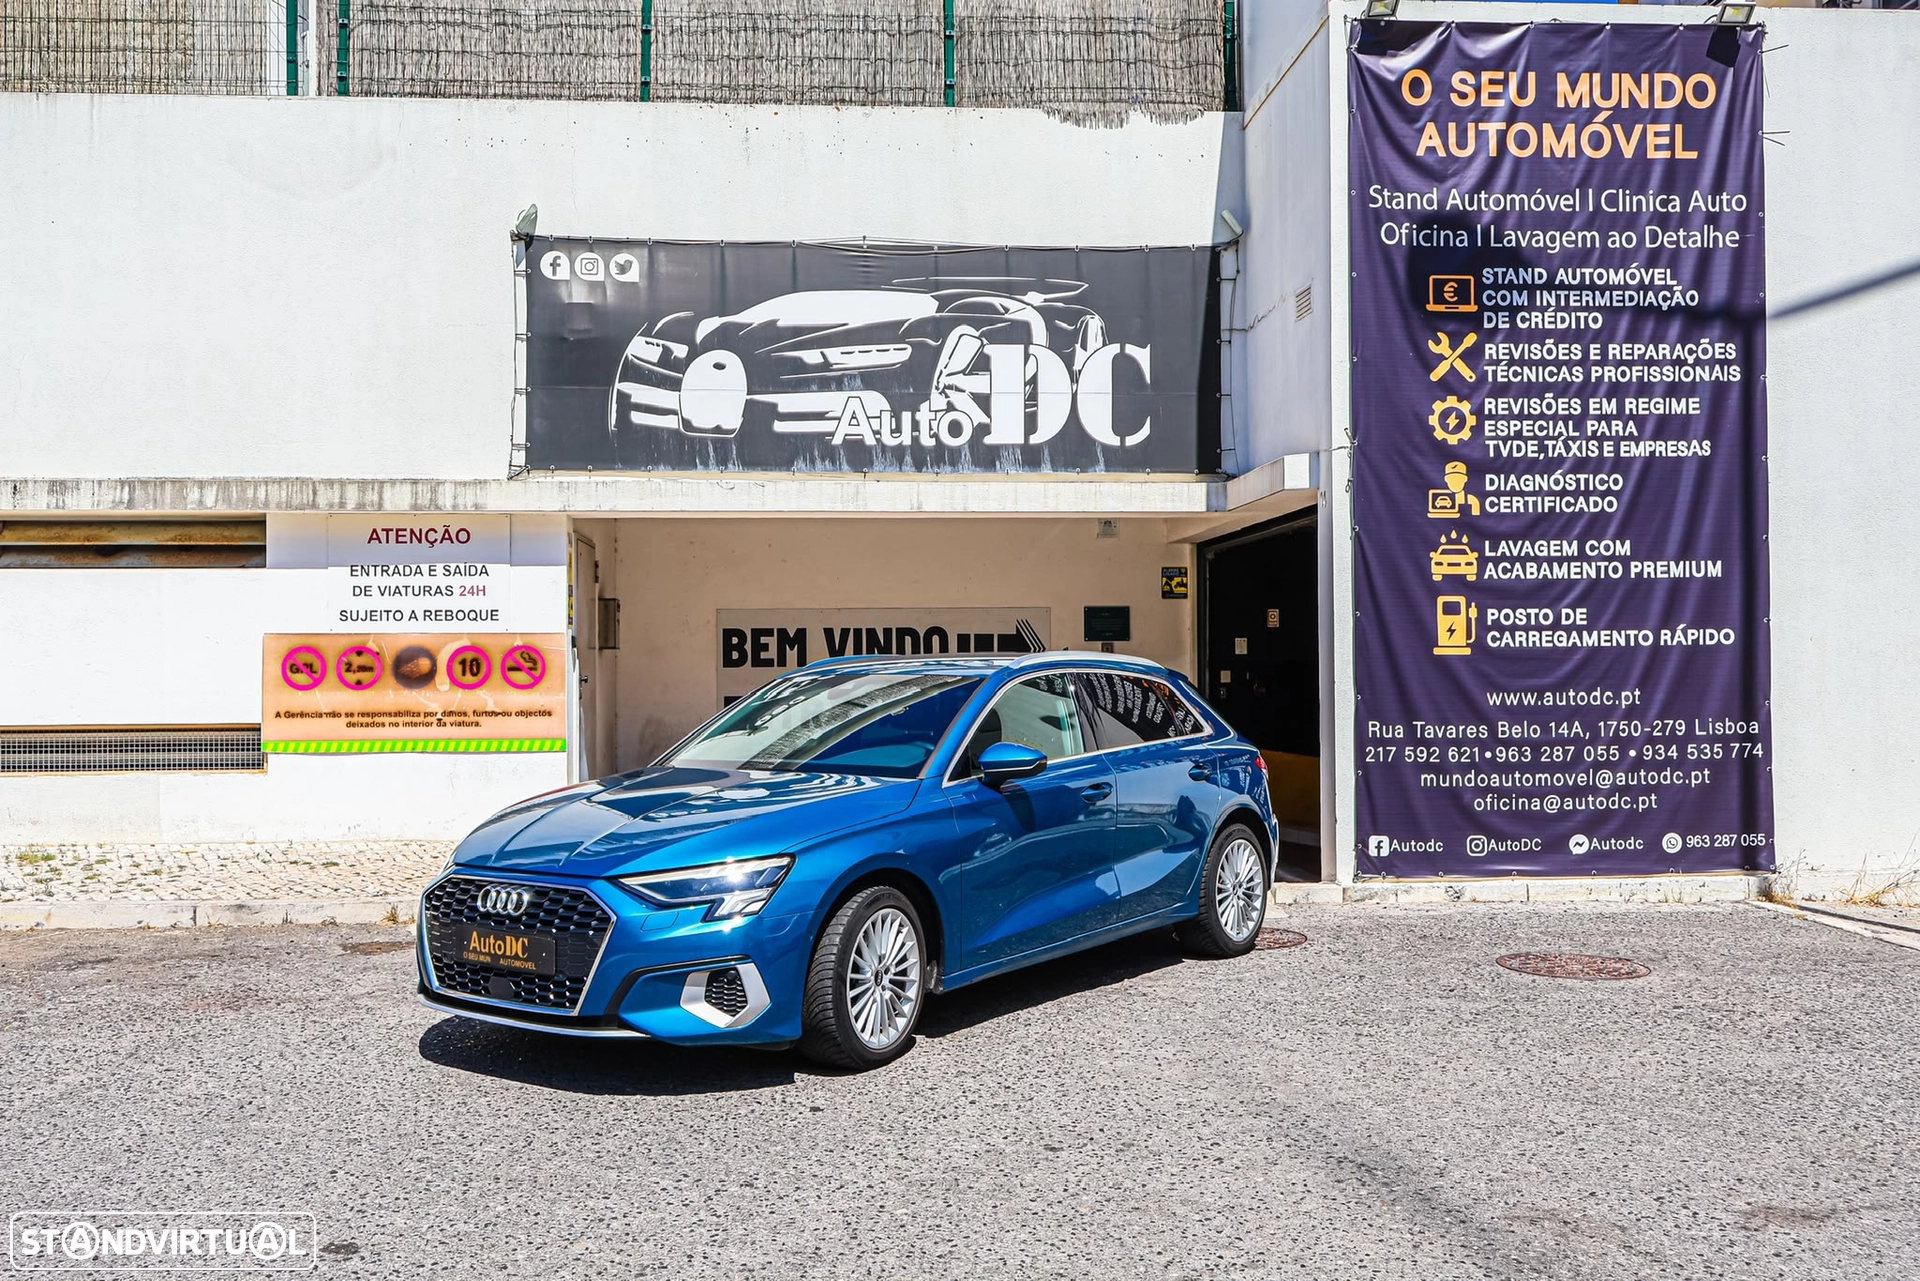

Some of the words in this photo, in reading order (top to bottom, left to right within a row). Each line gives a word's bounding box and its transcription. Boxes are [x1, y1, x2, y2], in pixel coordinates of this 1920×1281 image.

[1401, 69, 1432, 105] O
[1450, 70, 1537, 107] SEU
[1557, 73, 1716, 108] MUNDO
[1416, 111, 1698, 159] AUTOMÓVEL
[1369, 185, 1437, 210] Stand
[1446, 187, 1580, 211] Automóvel
[1601, 189, 1680, 212] Clinica
[1688, 190, 1746, 212] Auto
[1381, 222, 1468, 247] Oficina
[1491, 226, 1599, 253] Lavagem
[1608, 232, 1636, 248] ao
[1646, 225, 1739, 248] Detalhe
[1482, 268, 1547, 284] STAND
[1555, 263, 1677, 285] AUTOMÓVEL
[1483, 290, 1528, 306] COM
[1536, 285, 1698, 311] INTERMEDIAÇÃO
[1484, 312, 1509, 328] DE
[1517, 307, 1602, 329] CRÉDITO
[1485, 339, 1581, 359] REVISÕES
[1590, 344, 1601, 359] E
[1609, 338, 1736, 364] REPARAÇÕES
[1484, 361, 1583, 382] TÉCNICAS
[1591, 364, 1741, 382] PROFISSIONAIS
[831, 344, 1152, 447] AutoDC
[1485, 393, 1581, 415] REVISÕES
[1589, 398, 1616, 414] EM
[1625, 398, 1700, 414] REGIME
[1485, 420, 1579, 437] ESPECIAL
[1587, 420, 1638, 436] PARA
[1604, 441, 1614, 457] E
[1620, 440, 1710, 457] EMPRESAS
[1486, 470, 1623, 491] DIAGNÓSTICO
[1485, 496, 1617, 512] CERTIFICADO
[368, 525, 470, 548] ATENÇÃO
[1485, 540, 1577, 556] LAVAGEM
[1586, 540, 1630, 556] COM
[350, 565, 423, 576] ENTRADA
[429, 565, 437, 576] E
[442, 562, 489, 577] SAÍDA
[1484, 562, 1622, 579] ACABAMENTO
[1631, 561, 1721, 578] PREMIUM
[353, 586, 372, 596] DE
[378, 585, 453, 596] VIATURAS
[459, 585, 485, 596] 24H
[340, 610, 403, 621] SUJEITO
[408, 610, 418, 621] A
[424, 610, 499, 621] REBOQUE
[1488, 609, 1553, 625] POSTO
[1561, 608, 1587, 625] DE
[1487, 630, 1653, 647] CARREGAMENTO
[1661, 624, 1734, 645] RÁPIDO
[722, 628, 807, 668] BEM
[459, 658, 480, 677] 10
[1487, 688, 1640, 708] www.autodc.pt
[357, 710, 420, 719] responsabiliza
[515, 710, 552, 718] objectos
[436, 719, 446, 727] da
[1369, 721, 1403, 738] Rua
[1413, 722, 1487, 738] Tavares
[1498, 721, 1540, 738] Belo
[1549, 721, 1589, 739] 14A,
[1598, 720, 1685, 737] 1750-279
[1696, 718, 1758, 735] Lisboa
[1366, 747, 1396, 762] 217
[1405, 747, 1440, 762] 592
[1541, 746, 1574, 761] 287
[1584, 746, 1619, 761] 055
[1643, 745, 1678, 760] 934
[1687, 744, 1722, 759] 535
[1730, 743, 1763, 758] 774
[1421, 769, 1709, 789] mundoautomovel@autodc.pt
[1474, 793, 1657, 813] oficina@autodc.pt
[1391, 839, 1443, 851] Autodc
[1489, 838, 1541, 851] AutoDC
[1591, 837, 1643, 850] Autodc
[1714, 835, 1737, 847] 287
[1741, 834, 1765, 846] 055
[470, 931, 528, 958] AutoDC
